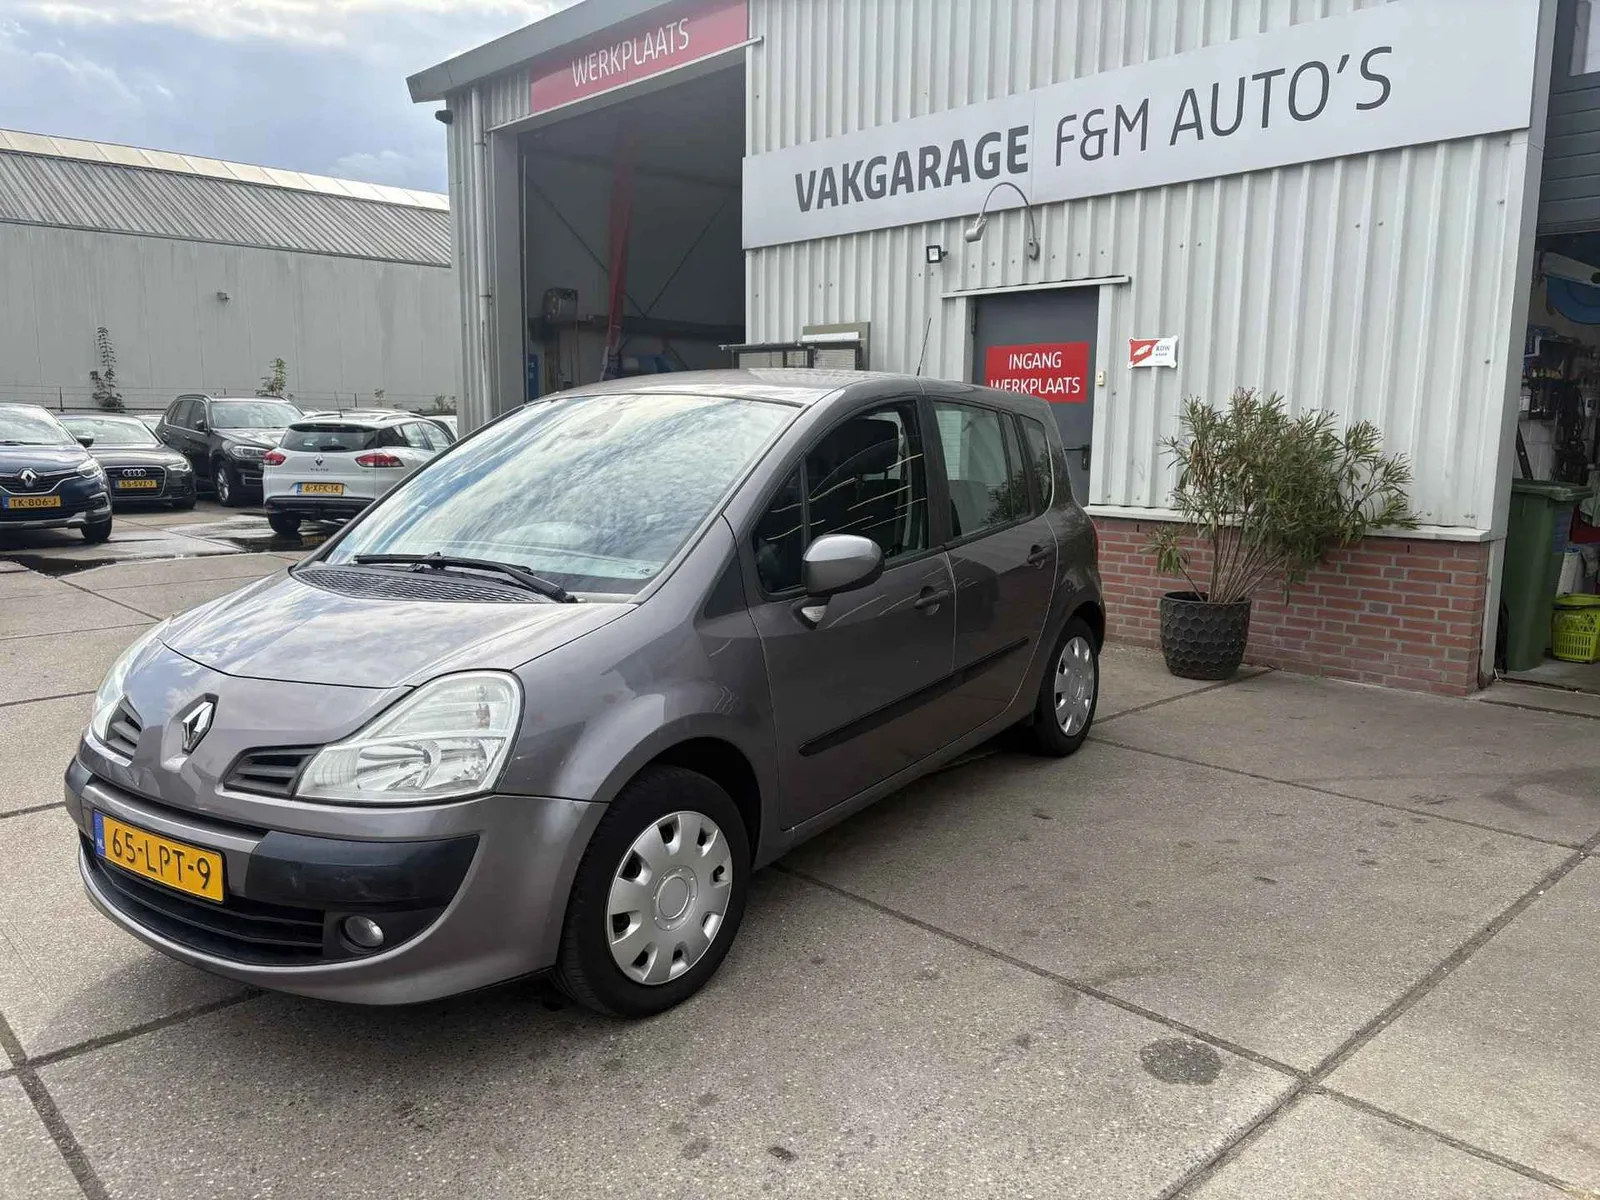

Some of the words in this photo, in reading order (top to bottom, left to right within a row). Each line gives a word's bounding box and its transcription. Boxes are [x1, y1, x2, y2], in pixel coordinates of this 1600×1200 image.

[571, 17, 689, 87] WERKPLAATS
[795, 125, 1029, 213] VAKGARAGE
[1055, 98, 1150, 167] F&M
[1169, 46, 1392, 146] AUTO'S
[1008, 351, 1062, 370] INGANG
[990, 377, 1080, 394] WERKPLAATS
[11, 498, 57, 507] TK-806-J
[112, 828, 211, 890] 65-LPT-9
